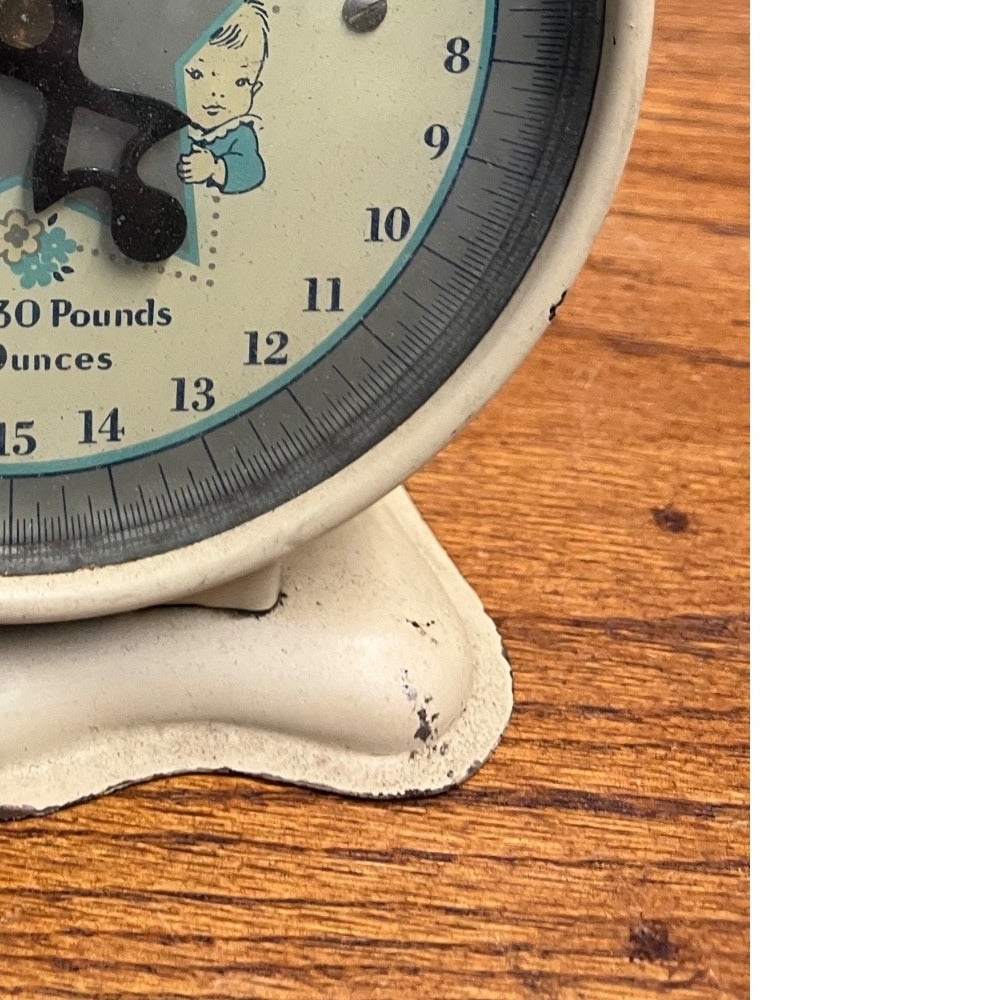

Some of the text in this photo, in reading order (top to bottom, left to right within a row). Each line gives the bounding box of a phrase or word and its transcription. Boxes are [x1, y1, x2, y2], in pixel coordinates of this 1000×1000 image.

[444, 37, 470, 73] 8
[424, 124, 449, 160] 9
[364, 207, 410, 242] 10
[303, 277, 343, 312] 11
[51, 299, 172, 327] Pounds
[244, 331, 288, 365] 12
[171, 378, 215, 411] 13
[78, 408, 124, 444] 14
